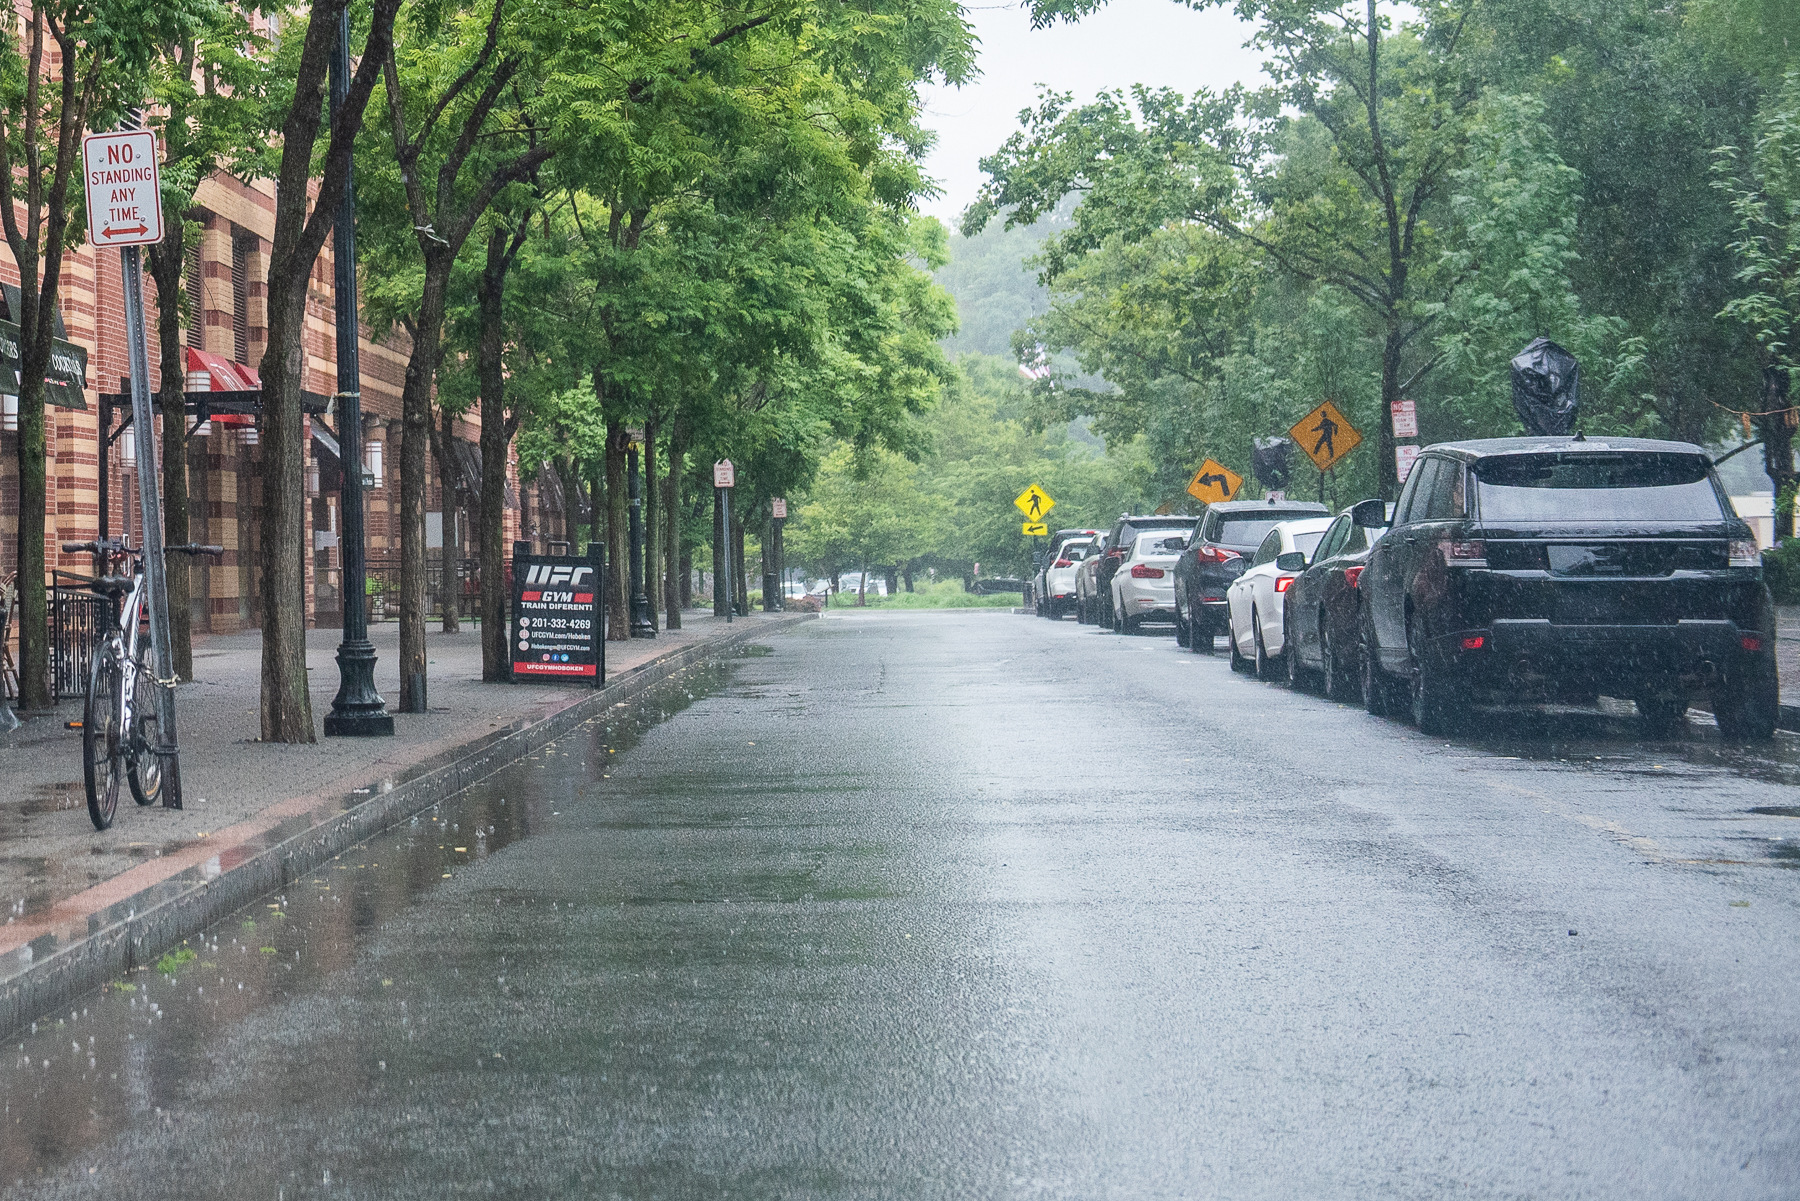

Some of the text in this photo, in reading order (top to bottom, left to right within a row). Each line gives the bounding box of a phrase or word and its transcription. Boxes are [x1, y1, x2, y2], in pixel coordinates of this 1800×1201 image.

[107, 143, 134, 166] NO
[91, 166, 152, 186] STANDING
[110, 187, 136, 203] ANY
[108, 206, 140, 222] TIME
[1531, 528, 1601, 536] ANGE
[525, 565, 594, 587] UFC
[542, 591, 573, 602] GYM
[531, 617, 591, 630] 201-332-4269
